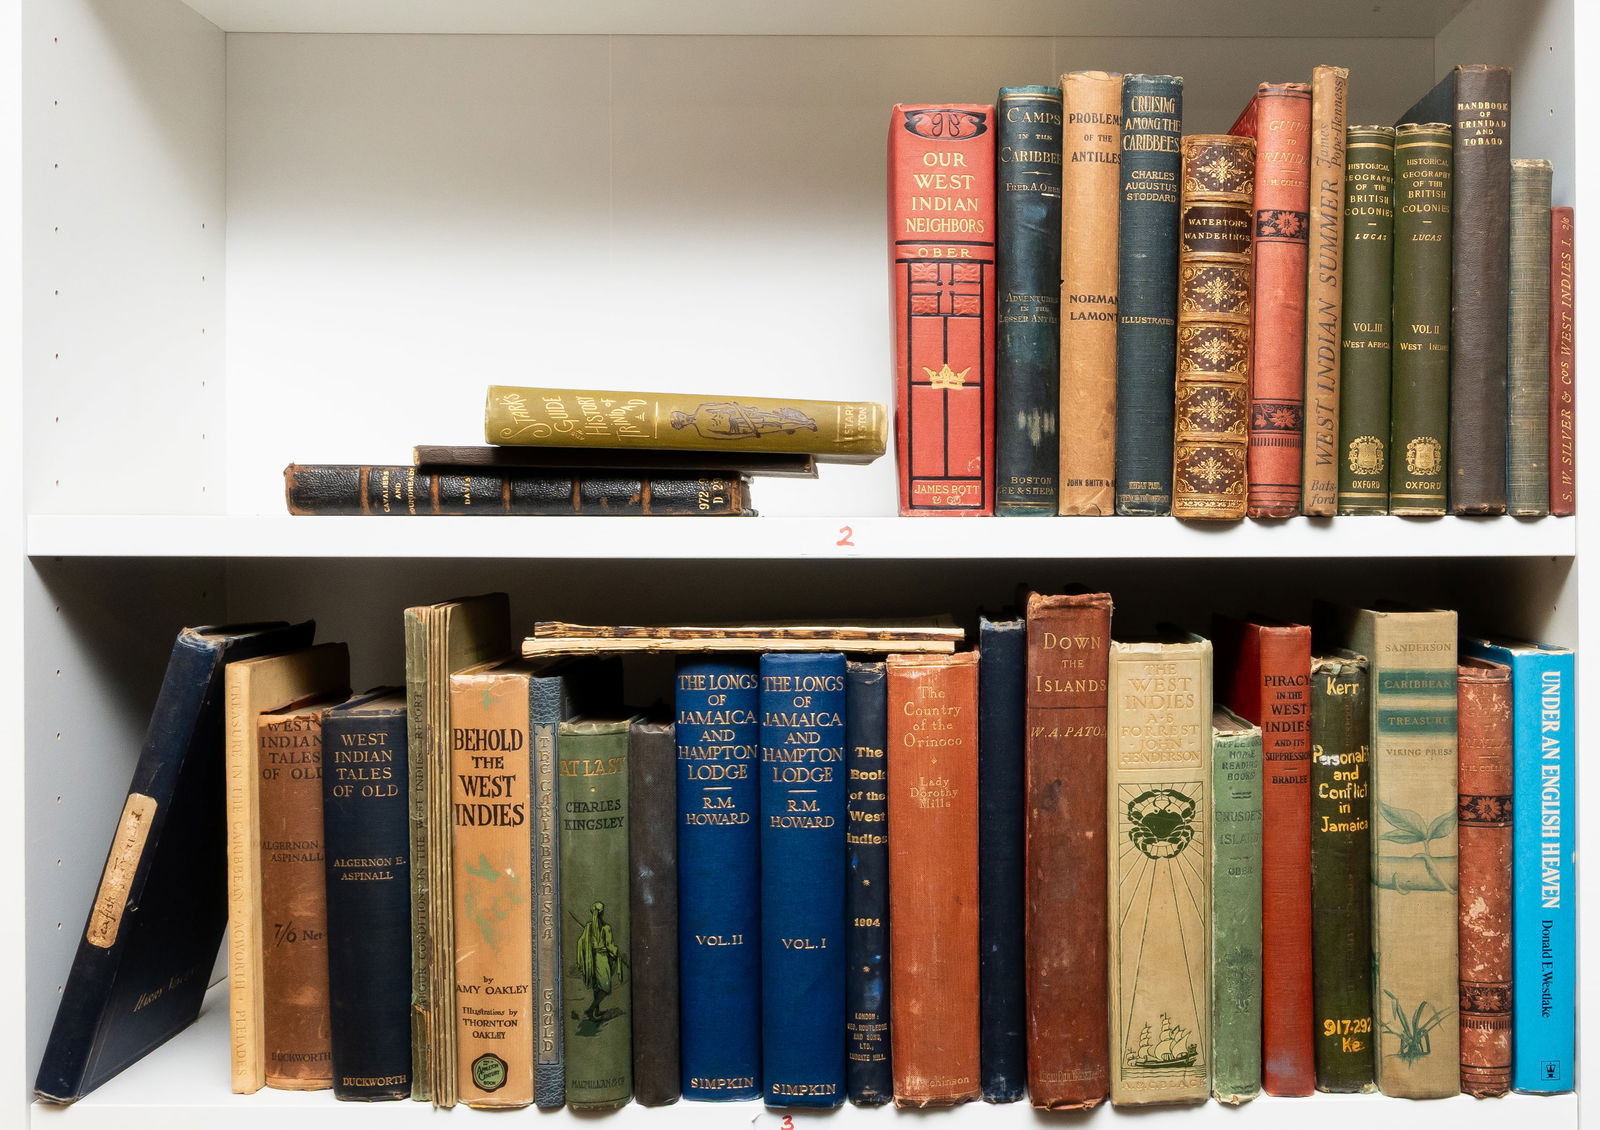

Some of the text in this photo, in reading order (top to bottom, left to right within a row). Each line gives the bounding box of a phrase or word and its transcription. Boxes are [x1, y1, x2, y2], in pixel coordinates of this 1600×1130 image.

[1131, 96, 1175, 114] CRUISING
[1458, 102, 1508, 110] HANDBOOK
[1125, 116, 1181, 132] AMONG THE
[1460, 120, 1506, 129] TRINIDAD
[1084, 134, 1112, 142] OF THE
[1124, 134, 1181, 152] CARIBBEES
[1464, 138, 1503, 146] TOBAGO
[923, 152, 967, 167] OUR
[1407, 158, 1448, 166] HISTORICAL
[913, 174, 976, 190] WEST
[1132, 170, 1174, 182] CHARLES
[1126, 182, 1177, 192] AUGUSTUS
[1412, 180, 1424, 188] OF
[1127, 192, 1176, 202] STODDARD
[1350, 195, 1388, 204] BRITISH
[1408, 190, 1446, 198] BRITISH
[911, 196, 978, 212] INDIAN
[905, 218, 984, 233] NEIGHBORS
[1184, 232, 1250, 242] WANDERINGS
[918, 247, 972, 258] OBER
[1122, 316, 1174, 326] ILLUSTRATED
[1316, 179, 1340, 467] WEST INDIAN SUMMER
[1343, 340, 1364, 348] WEST
[1400, 342, 1422, 350] WEST
[1560, 253, 1572, 465] SILVER WEST INDIES
[543, 396, 579, 432] GUIDE
[914, 484, 949, 494] JAMES
[1067, 479, 1082, 487] JOHN
[1311, 479, 1337, 492] Bats-
[1352, 480, 1380, 489] OXFORD
[1406, 481, 1441, 490] OXFORD
[1310, 493, 1336, 506] ford
[836, 526, 855, 546] 2
[1044, 632, 1100, 649] DOWN
[1385, 643, 1452, 652] SANDERSON
[1062, 660, 1084, 668] THE
[1144, 664, 1177, 675] THE
[678, 674, 758, 690] THE LONGS
[763, 676, 844, 692] THE LONGS
[1036, 676, 1107, 692] ISLANDS
[1128, 678, 1192, 692] WEST
[1264, 676, 1312, 687] PIRACY
[1326, 677, 1360, 696] Kerr
[1384, 680, 1449, 689] CARIBBEAN
[918, 686, 946, 698] The
[1276, 692, 1302, 700] IN THE
[708, 694, 727, 706] OF
[794, 697, 812, 708] OF
[1124, 694, 1194, 710] INDIES
[904, 702, 961, 717] Country
[1272, 704, 1308, 715] WEST
[232, 681, 241, 758] TREASURE
[678, 710, 758, 725] JAMAICA
[763, 713, 843, 726] JAMAICA
[1388, 716, 1448, 726] TREASURE
[913, 719, 952, 730] of the
[1265, 722, 1311, 732] INDIES
[700, 730, 736, 742] AND
[1122, 725, 1200, 738] FORREST
[341, 734, 388, 746] WEST
[454, 728, 523, 752] BEHOLD
[784, 732, 820, 744] AND
[904, 732, 962, 748] Orinoco
[1293, 739, 1304, 747] ITS
[269, 752, 320, 764] TALES
[335, 750, 392, 763] INDIAN
[678, 745, 758, 760] HAMPTON
[762, 748, 843, 762] HAMPTON
[855, 746, 884, 758] The
[1120, 752, 1200, 764] HENDERSON
[1386, 748, 1422, 756] VIKING
[472, 756, 504, 769] THE
[560, 757, 626, 776] AT LAST
[262, 768, 280, 780] OF
[336, 768, 392, 780] TALES
[688, 764, 748, 780] LODGE
[773, 768, 832, 782] LODGE
[850, 770, 886, 780] Book
[1334, 765, 1359, 780] and
[920, 777, 950, 788] Lady
[1272, 776, 1308, 784] BRADLEE
[334, 785, 398, 798] OF OLD
[458, 775, 516, 798] WEST
[1319, 782, 1368, 798] Conflict
[1542, 671, 1560, 908] UNDER AN ENGLISH HEAVEN
[850, 792, 886, 801] of the
[910, 787, 959, 799] Dorothy
[566, 800, 621, 813] CHARLES
[1340, 802, 1350, 813] in
[455, 804, 524, 827] INDIES
[686, 812, 750, 825] HOWARD
[850, 810, 885, 822] West
[564, 816, 625, 830] KINGSLEY
[770, 816, 834, 828] HOWARD
[1321, 816, 1368, 833] Jamaica
[262, 840, 318, 850] ALGERNON
[233, 820, 244, 903] CARIBBEAN
[334, 858, 392, 868] ALGERNON
[341, 871, 392, 882] ASPINALL
[274, 920, 296, 947] 7/6
[1542, 920, 1553, 958] Donald
[484, 976, 494, 984] by
[457, 985, 528, 995] AMY OAKLEY
[462, 1006, 504, 1016] Illustrations
[463, 1018, 518, 1027] THORNTON
[543, 988, 553, 1052] GOULD
[472, 1030, 506, 1040] OAKLEY
[272, 1052, 330, 1062] DUCKWORTH
[344, 1074, 406, 1086] DUCKWORTH
[691, 1076, 754, 1090] SIMPKIN
[772, 1083, 836, 1096] SIMPKIN
[781, 1114, 794, 1130] 3
